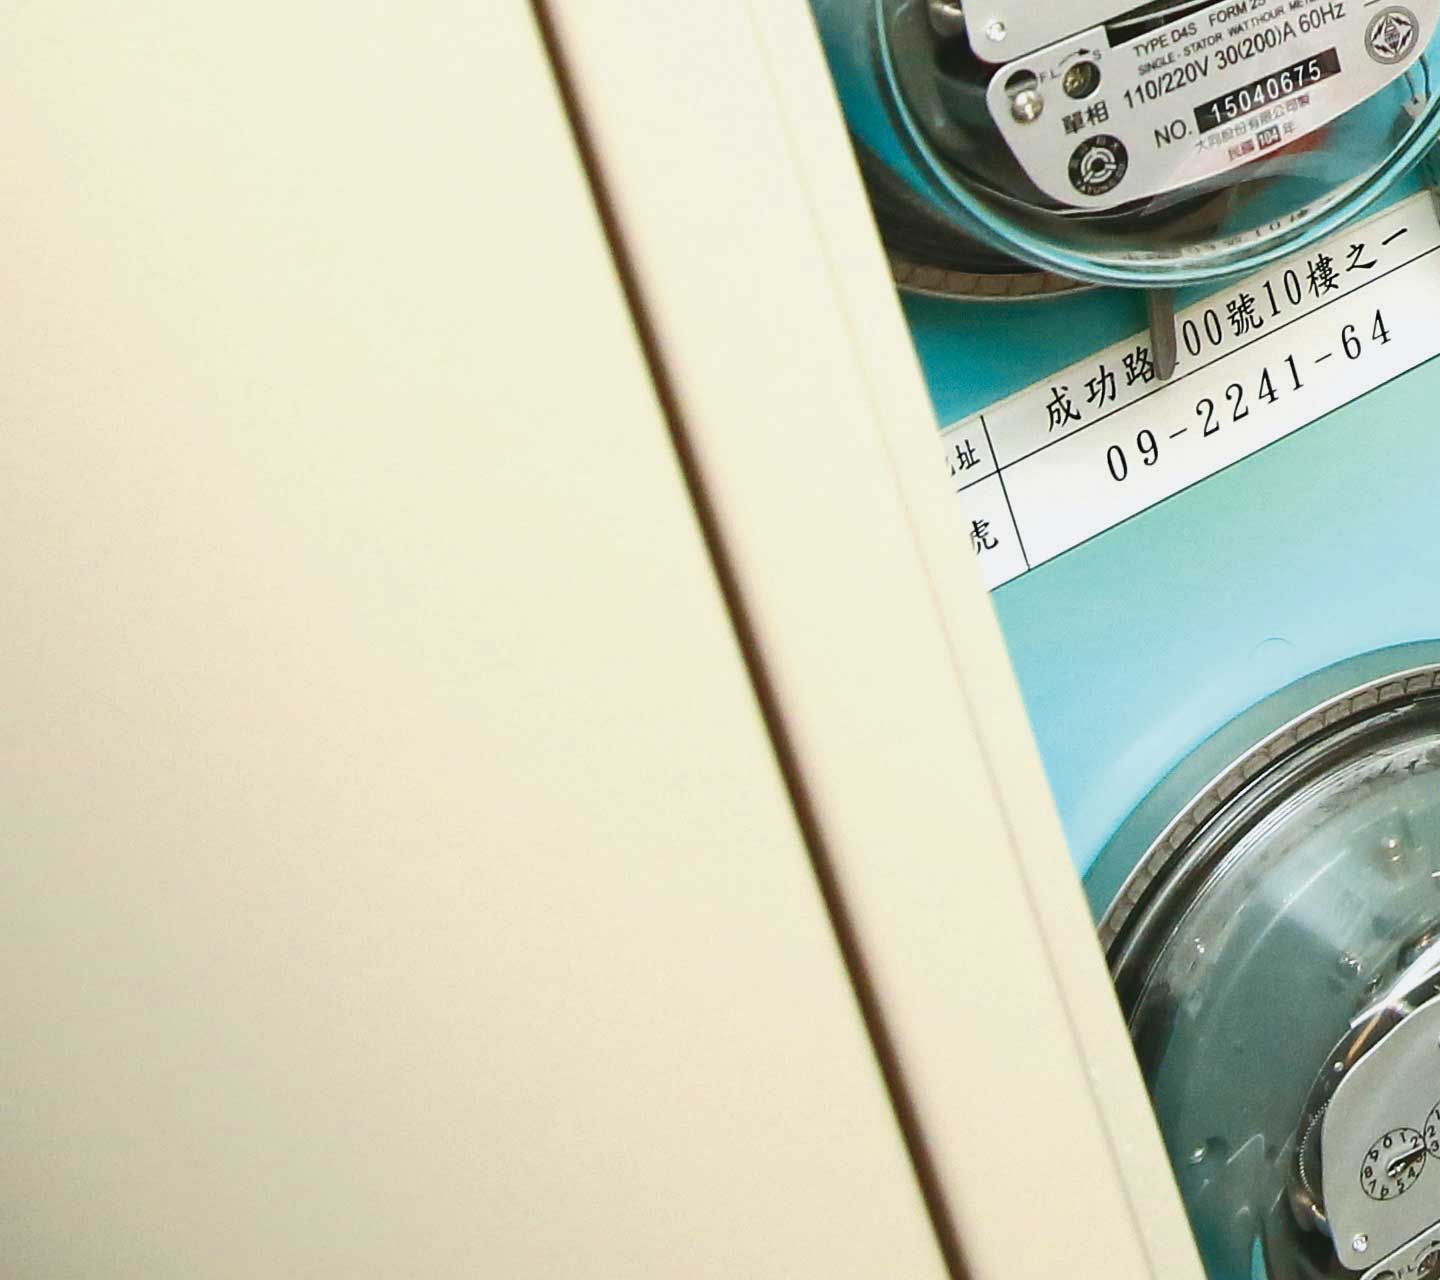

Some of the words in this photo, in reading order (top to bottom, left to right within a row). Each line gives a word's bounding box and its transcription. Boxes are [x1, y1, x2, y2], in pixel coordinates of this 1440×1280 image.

[1124, 58, 1209, 110] 110/220V
[1216, 25, 1295, 71] 30(200)A
[1298, 3, 1346, 34] 60Hz
[1133, 35, 1169, 57] TYPE
[1170, 24, 1198, 47] D4S
[1208, 4, 1248, 28] FORM
[1228, 4, 1285, 36] WATTHOUR
[1062, 100, 1110, 136] 單相
[1154, 119, 1192, 149] NO.
[1210, 62, 1322, 124] 15040675
[1046, 226, 1410, 432] 成功路00號10樓之一
[1105, 308, 1393, 483] 09-2241-64
